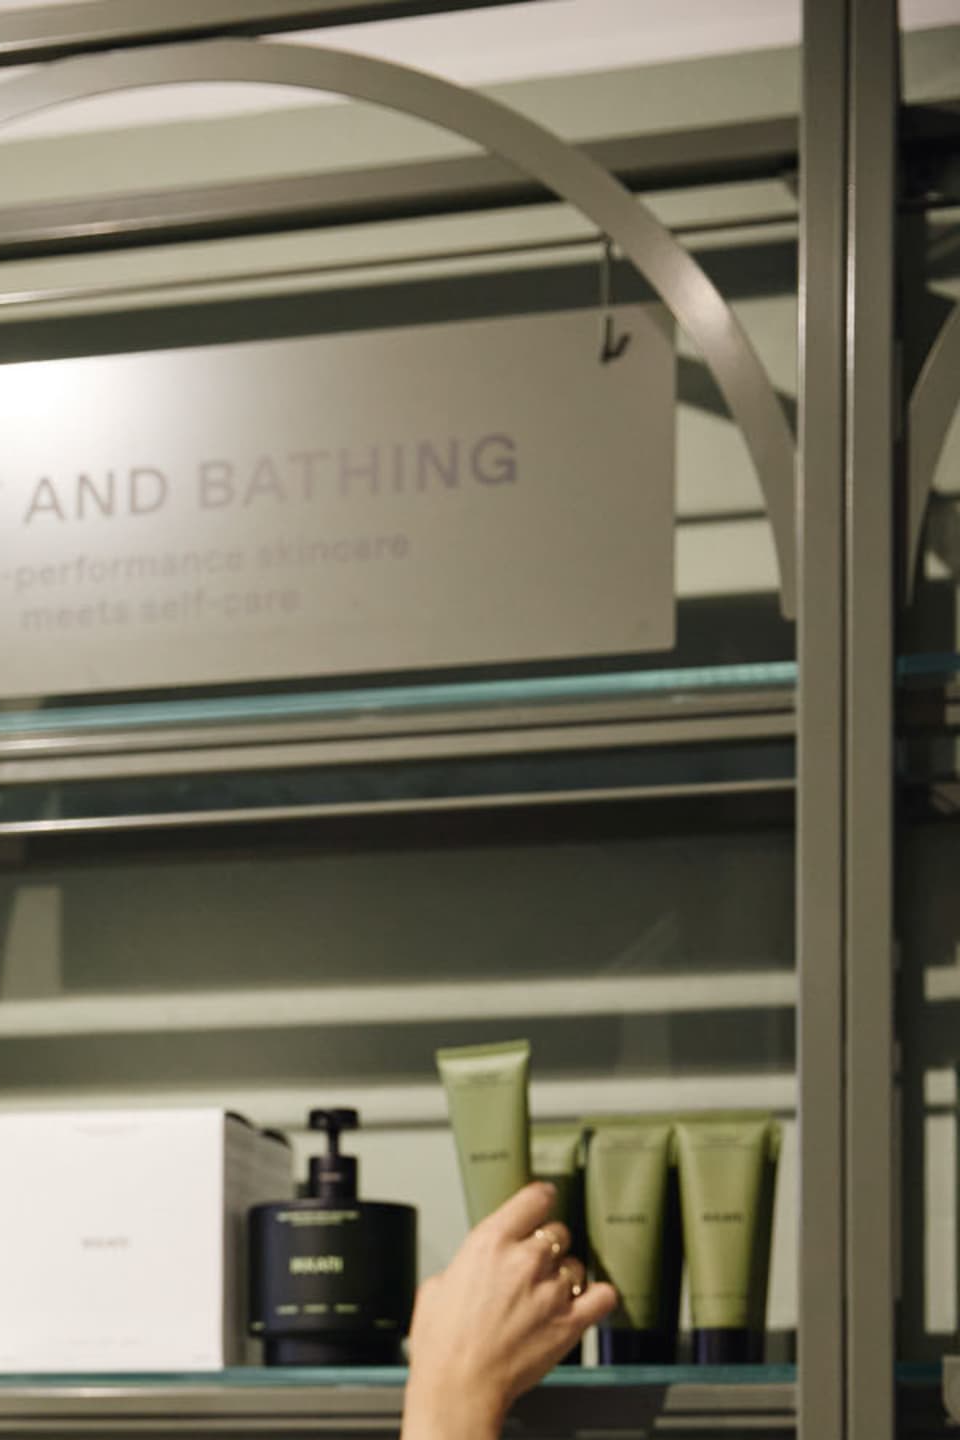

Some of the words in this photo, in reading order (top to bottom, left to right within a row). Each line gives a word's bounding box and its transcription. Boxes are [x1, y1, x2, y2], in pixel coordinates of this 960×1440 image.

[23, 466, 170, 525] AND
[198, 431, 519, 512] BATHING
[260, 533, 412, 569] skincare
